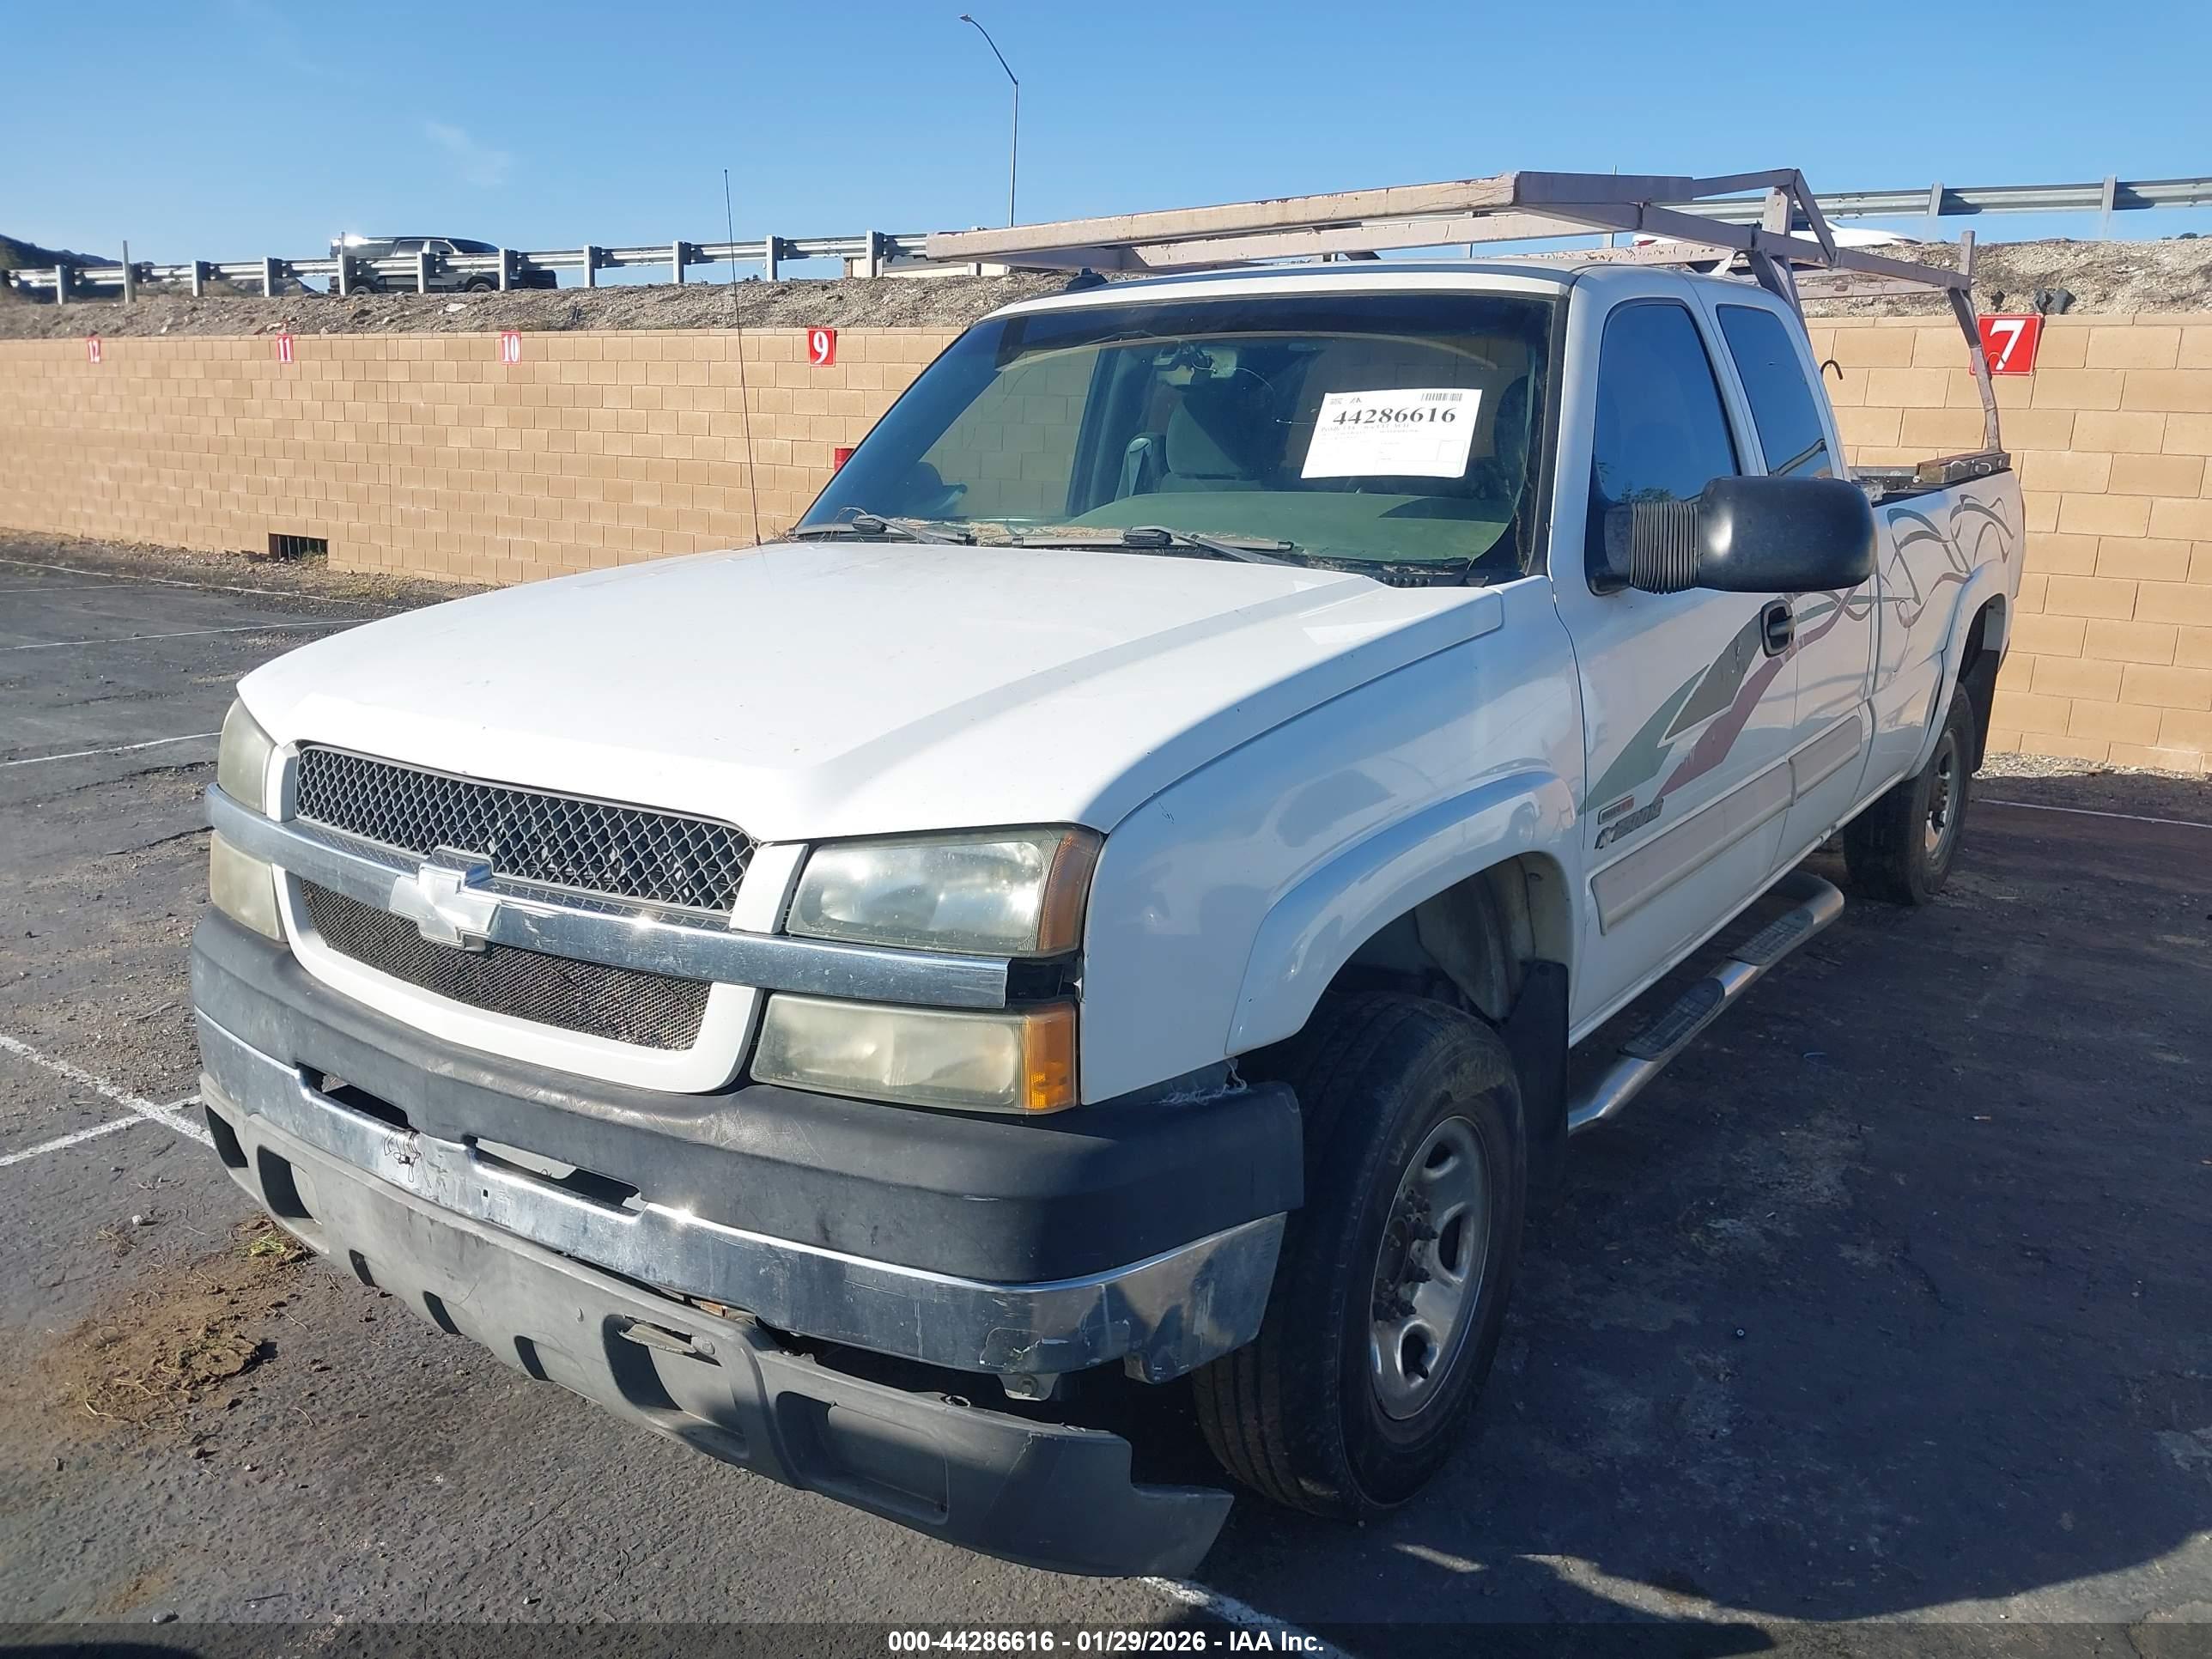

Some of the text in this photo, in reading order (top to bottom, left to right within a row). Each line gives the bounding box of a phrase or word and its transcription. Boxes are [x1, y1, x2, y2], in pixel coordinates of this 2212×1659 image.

[88, 339, 101, 363] 12
[276, 337, 292, 362] 11
[501, 334, 520, 362] 10
[812, 331, 830, 365] 9
[1989, 319, 2027, 371] 7
[1332, 406, 1457, 425] 44286616
